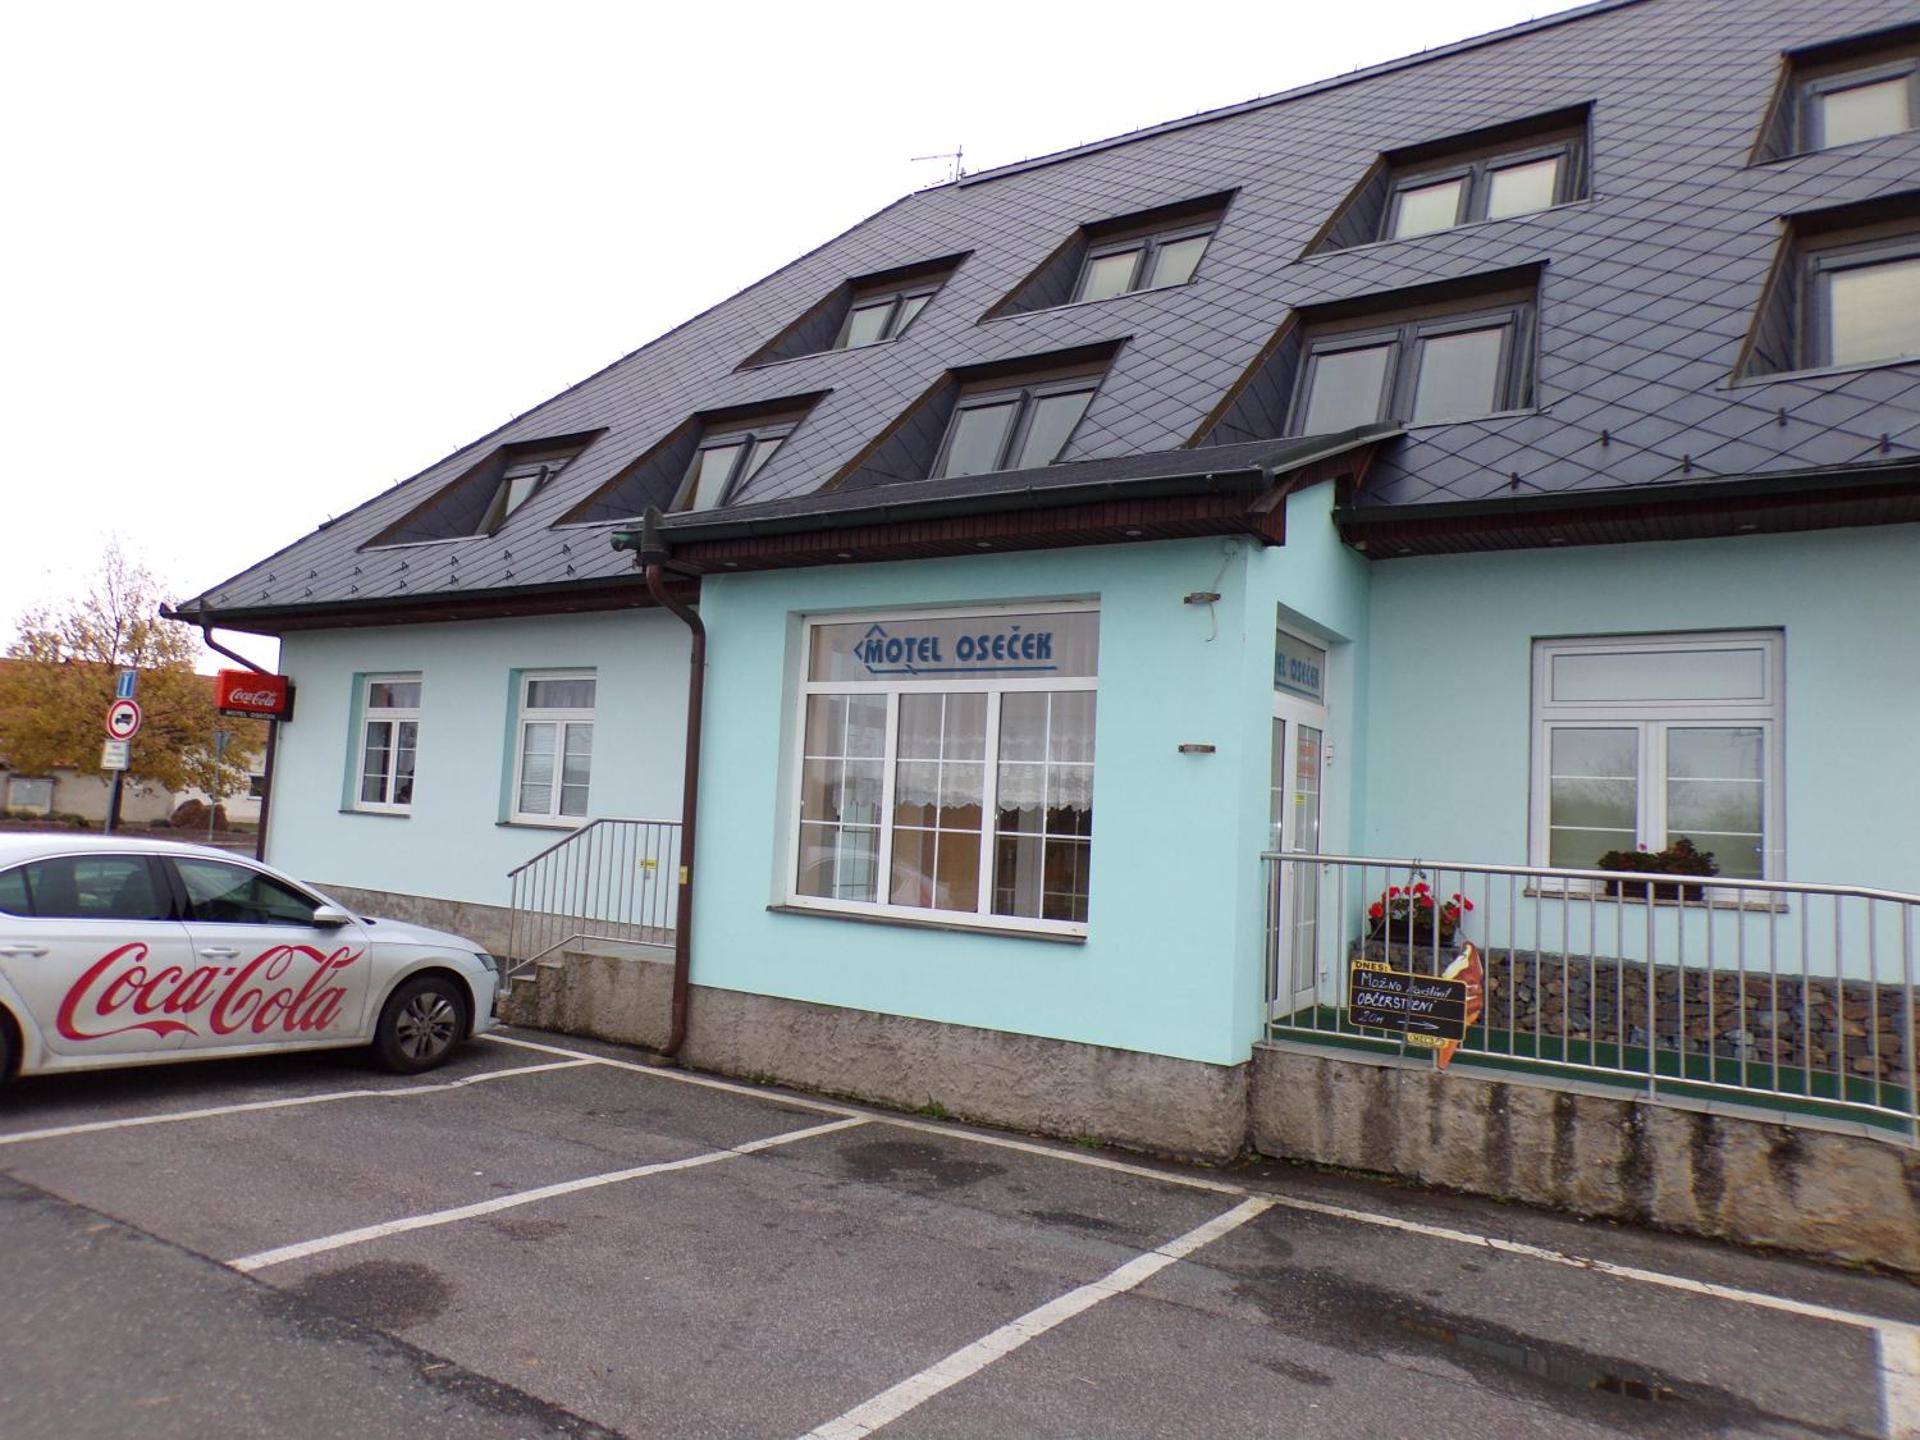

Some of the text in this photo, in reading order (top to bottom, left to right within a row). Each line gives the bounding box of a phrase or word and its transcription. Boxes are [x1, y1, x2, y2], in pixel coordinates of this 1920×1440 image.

[864, 626, 1054, 664] MOTEL OSEČEK
[56, 942, 364, 1040] Coca-Cola
